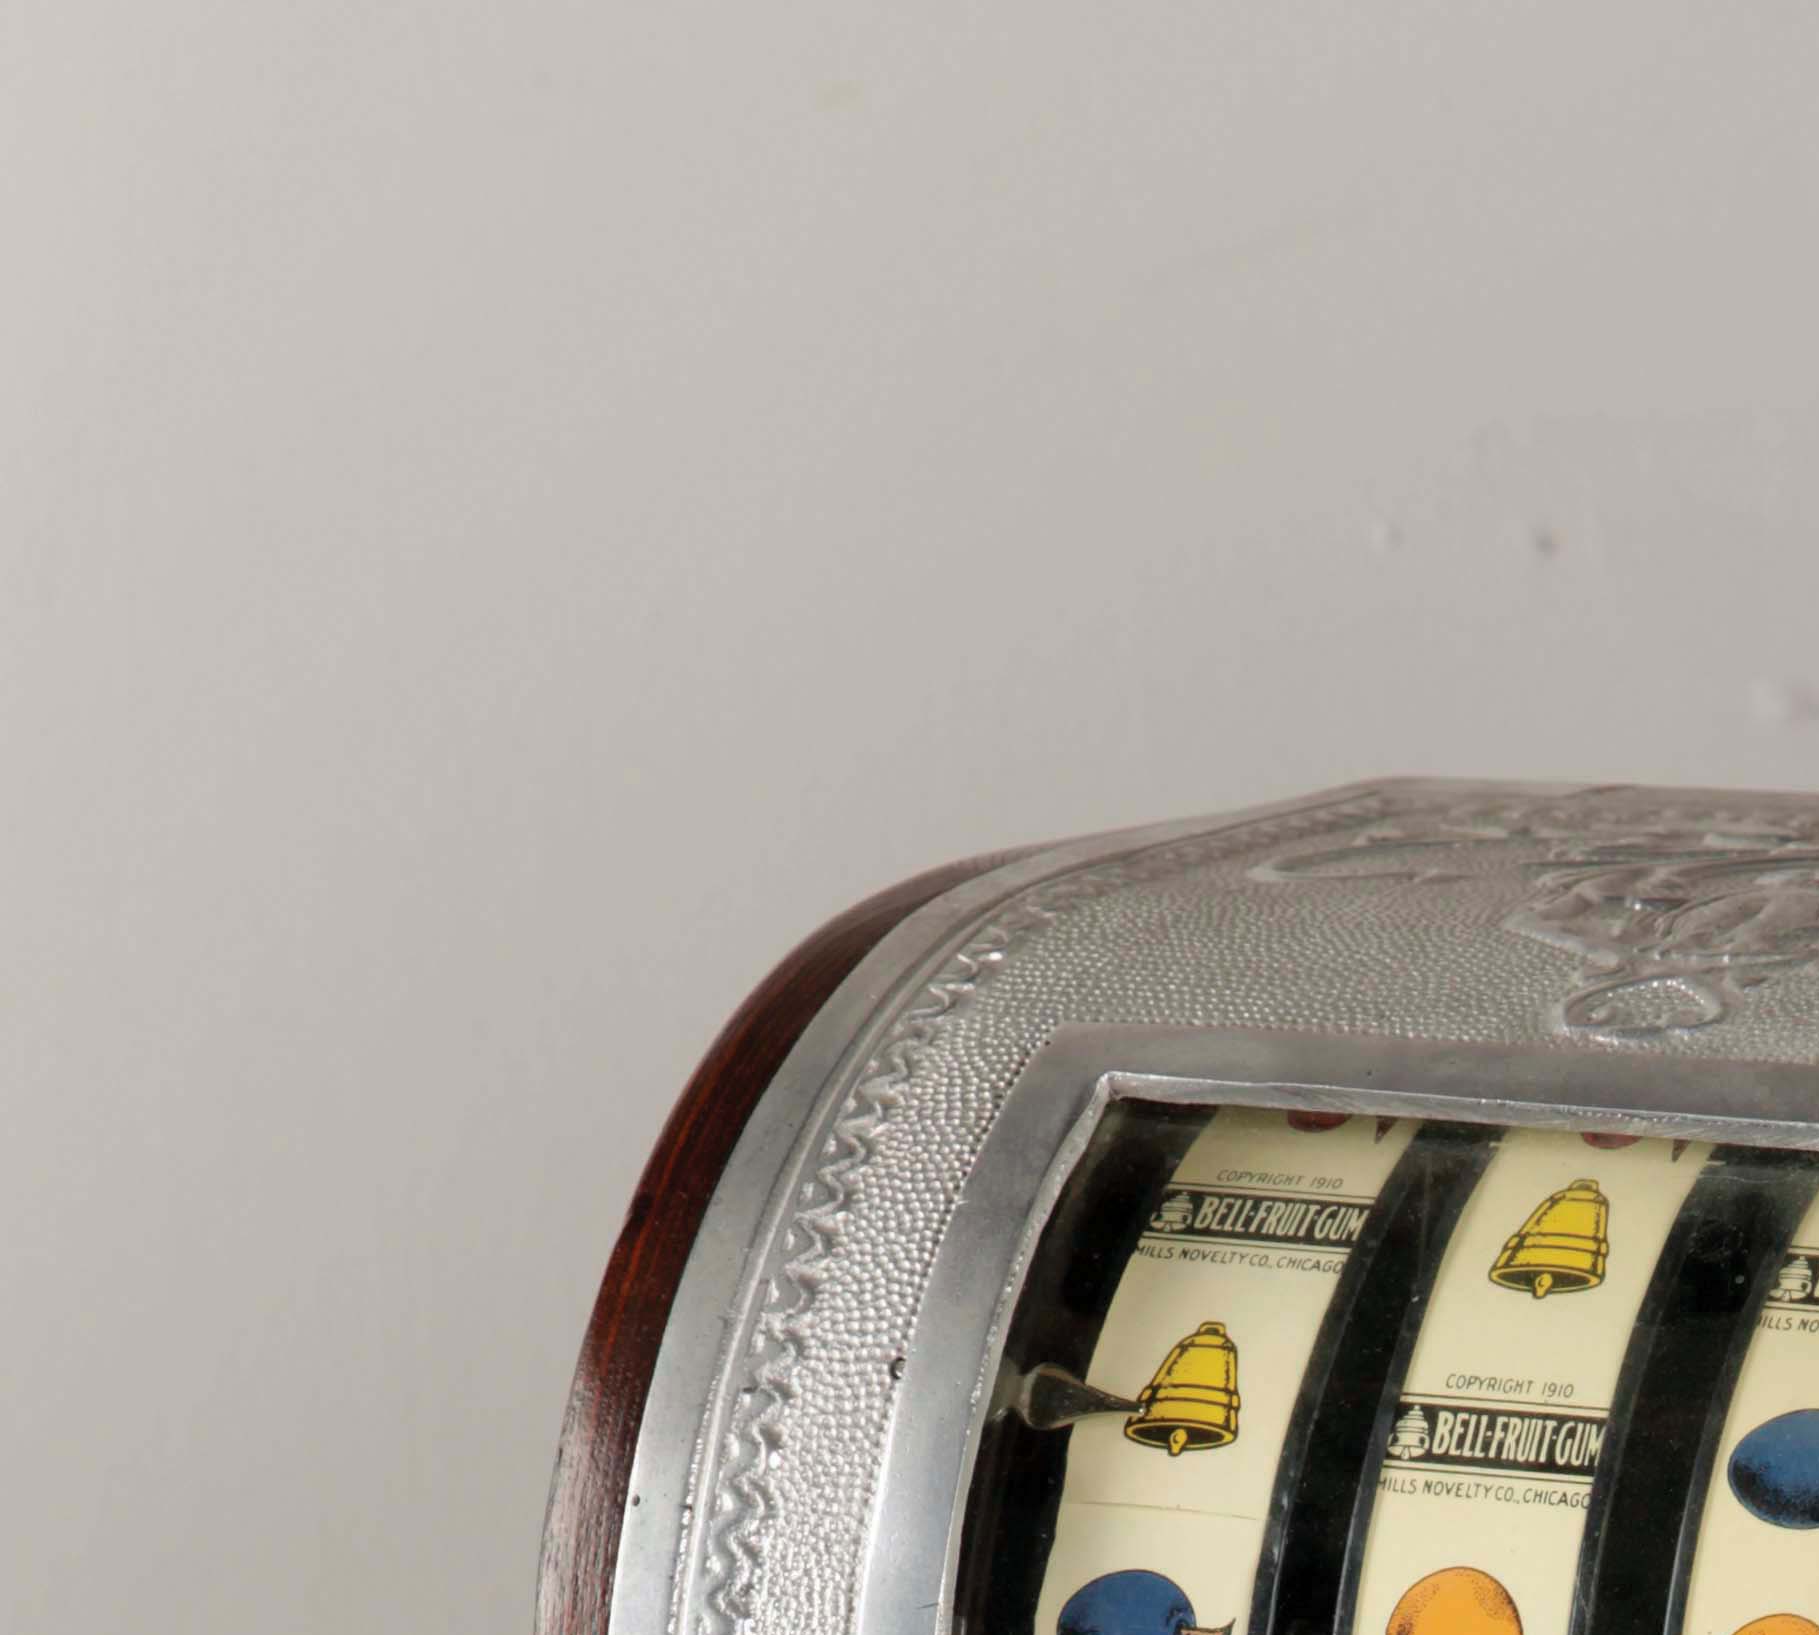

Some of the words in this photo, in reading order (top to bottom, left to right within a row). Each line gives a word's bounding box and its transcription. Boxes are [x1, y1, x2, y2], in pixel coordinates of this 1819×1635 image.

[1216, 1169, 1304, 1187] COPYRIGHT
[1310, 1176, 1344, 1190] 1910
[1178, 1247, 1249, 1265] NOVELTY
[1276, 1256, 1345, 1274] CHICAGO
[1760, 1315, 1793, 1331] ILLS
[1445, 1373, 1534, 1395] COPYRIGHT
[1541, 1382, 1575, 1399] 1910
[1422, 1476, 1493, 1499] NOVELTY
[1523, 1487, 1592, 1510] CHICAGO
